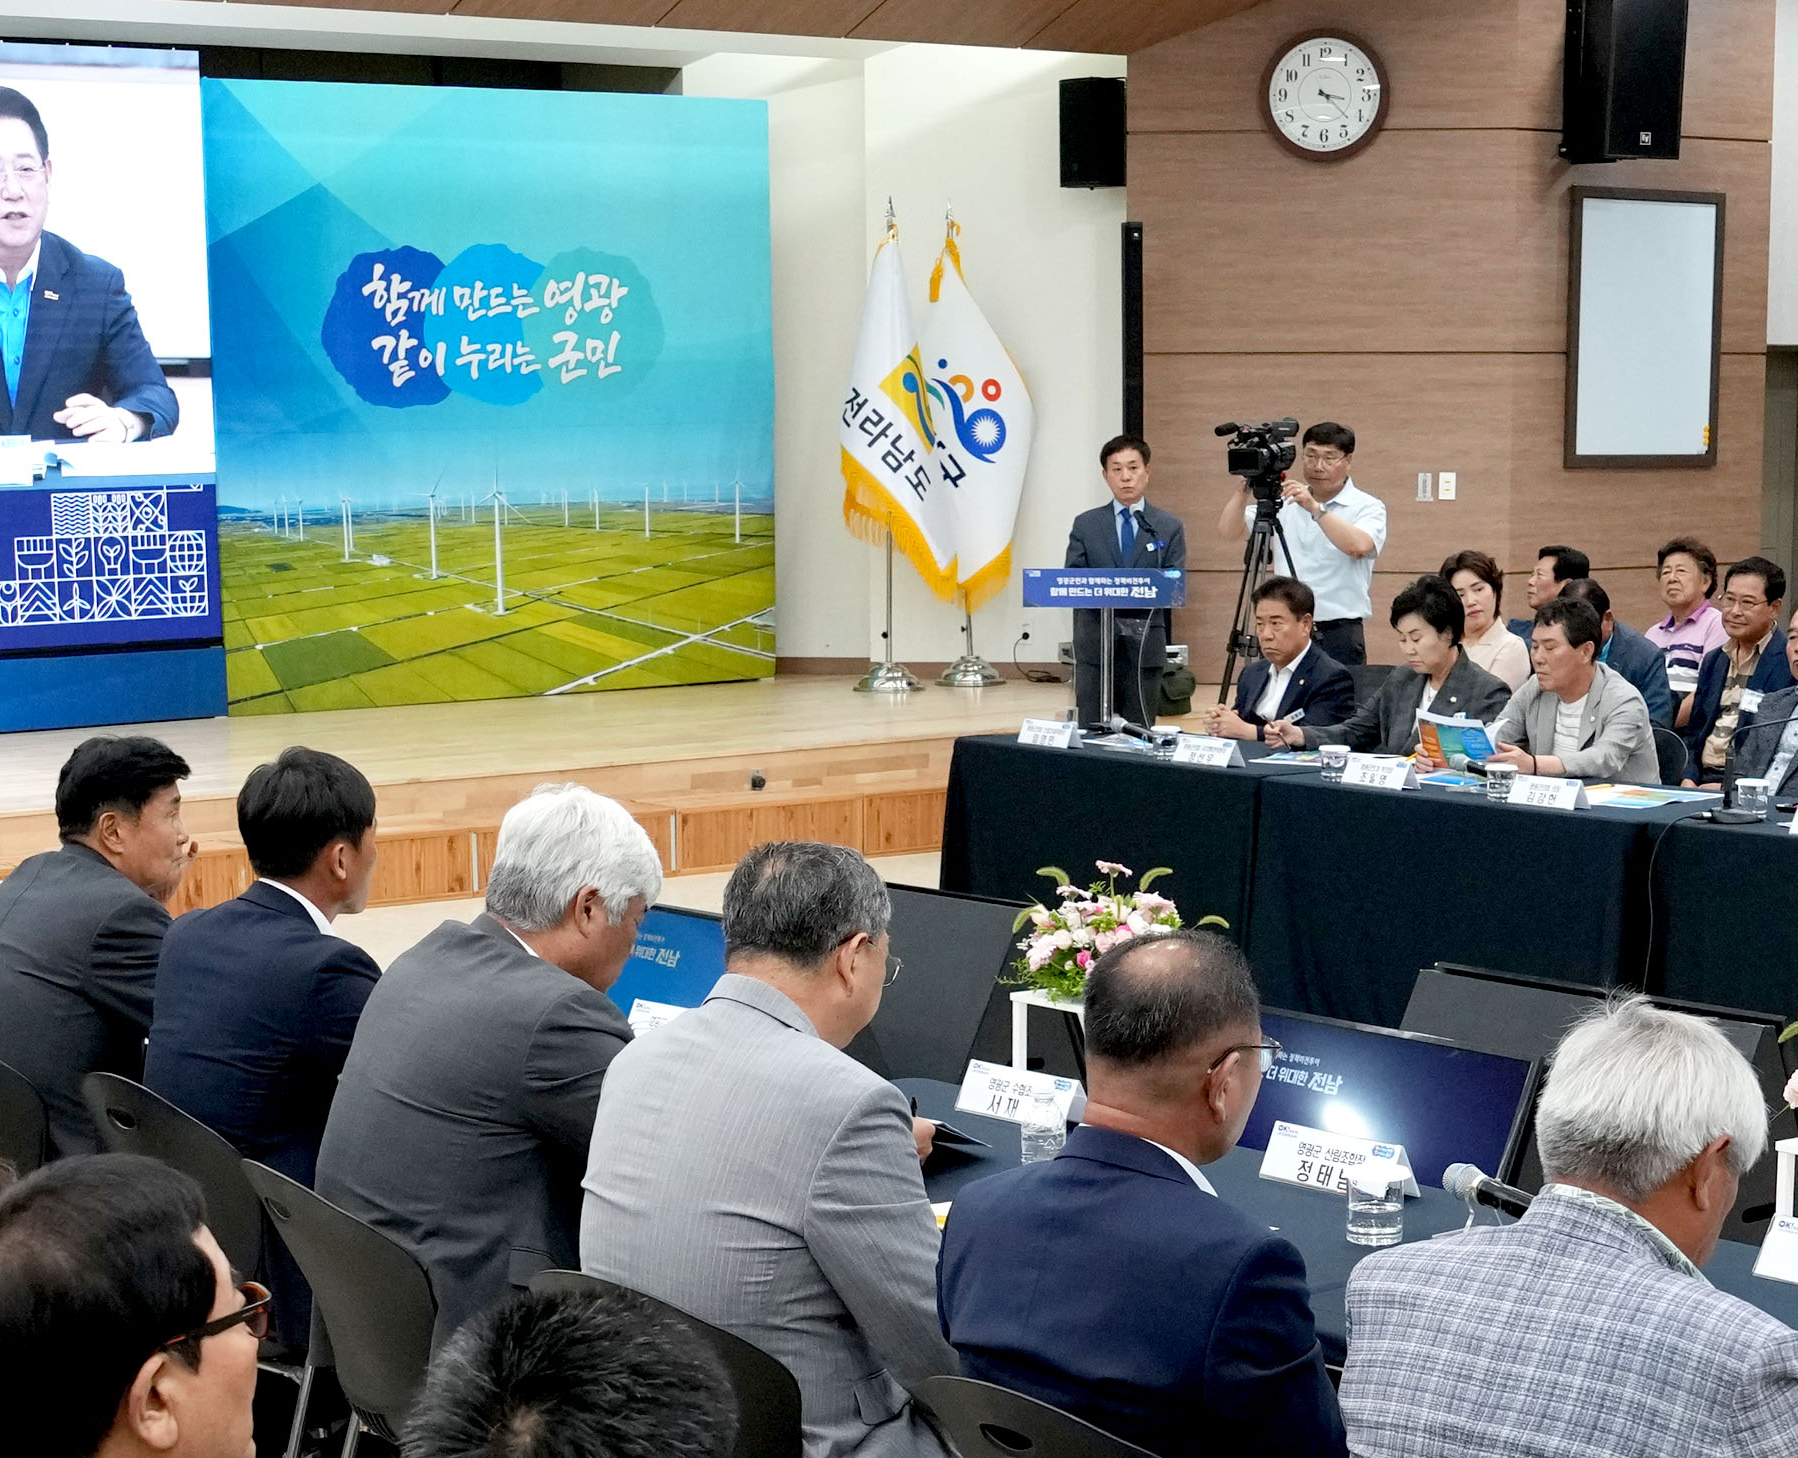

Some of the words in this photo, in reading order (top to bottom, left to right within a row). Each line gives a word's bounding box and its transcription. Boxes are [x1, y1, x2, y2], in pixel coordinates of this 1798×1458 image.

[1302, 54, 1310, 66] 11
[1286, 69, 1298, 82] 10
[1356, 68, 1365, 82] 2
[1278, 88, 1288, 102] 9
[1362, 88, 1371, 102] 3
[1285, 109, 1294, 123] 8
[1301, 125, 1309, 137] 7
[1319, 129, 1329, 142] 6
[1339, 125, 1348, 138] 5
[362, 263, 447, 327] 함께
[453, 280, 540, 321] 만드는
[544, 271, 629, 325] 영광
[371, 329, 447, 387] 같이
[455, 335, 542, 380] 누리는
[548, 330, 622, 384] 군민
[842, 387, 931, 502] 전라남도
[1130, 586, 1158, 598] 전남
[656, 948, 680, 968] 전남
[1266, 1065, 1277, 1080] 더
[1278, 1066, 1308, 1086] 위대한
[1308, 1072, 1343, 1095] 전남
[988, 1078, 1010, 1093] 영광군
[1012, 1083, 1032, 1097] 수협조
[987, 1094, 1020, 1119] 서재
[1297, 1141, 1322, 1158] 영광군
[1324, 1147, 1366, 1165] 산림조합장
